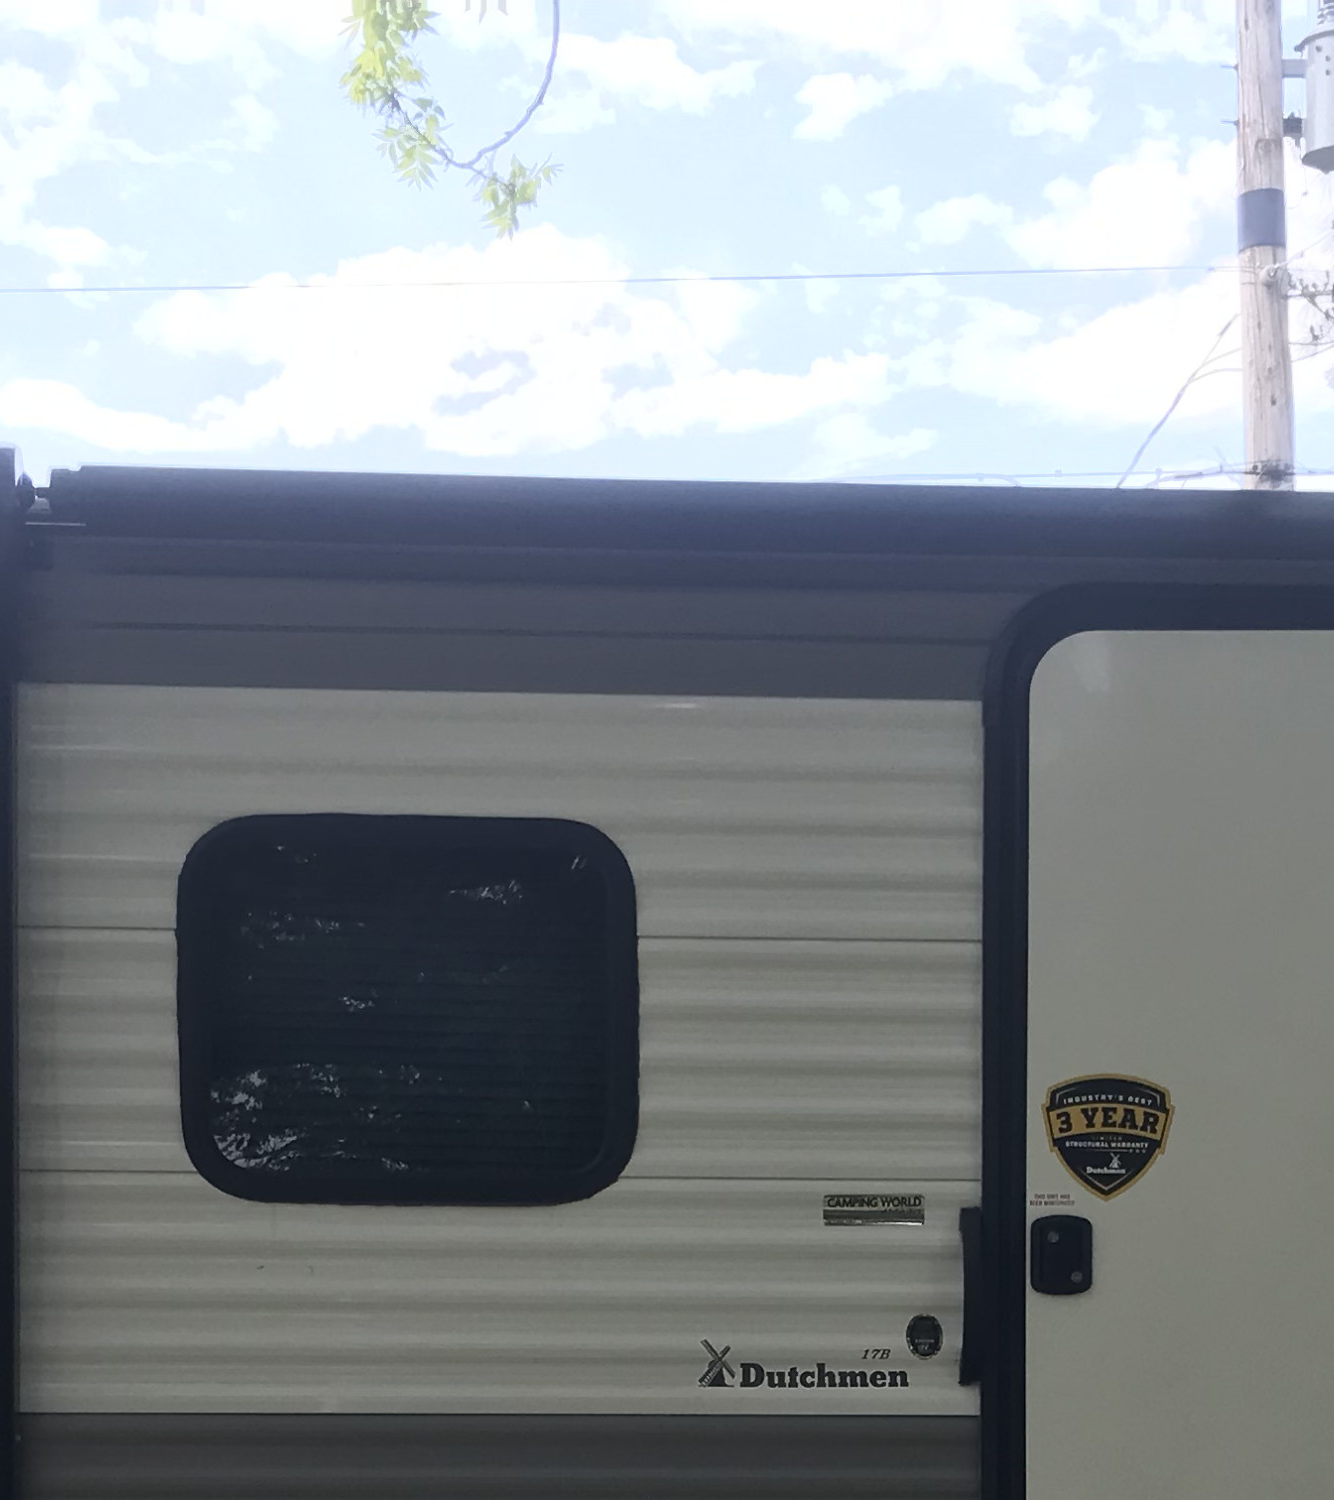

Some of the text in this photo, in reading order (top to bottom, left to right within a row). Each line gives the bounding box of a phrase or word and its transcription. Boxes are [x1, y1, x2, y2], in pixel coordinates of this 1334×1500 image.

[1128, 1095, 1153, 1106] BEST
[1056, 1106, 1160, 1135] 3 YEAR
[826, 1195, 923, 1208] CAMPING WORLD
[739, 1362, 910, 1389] Dutchmen
